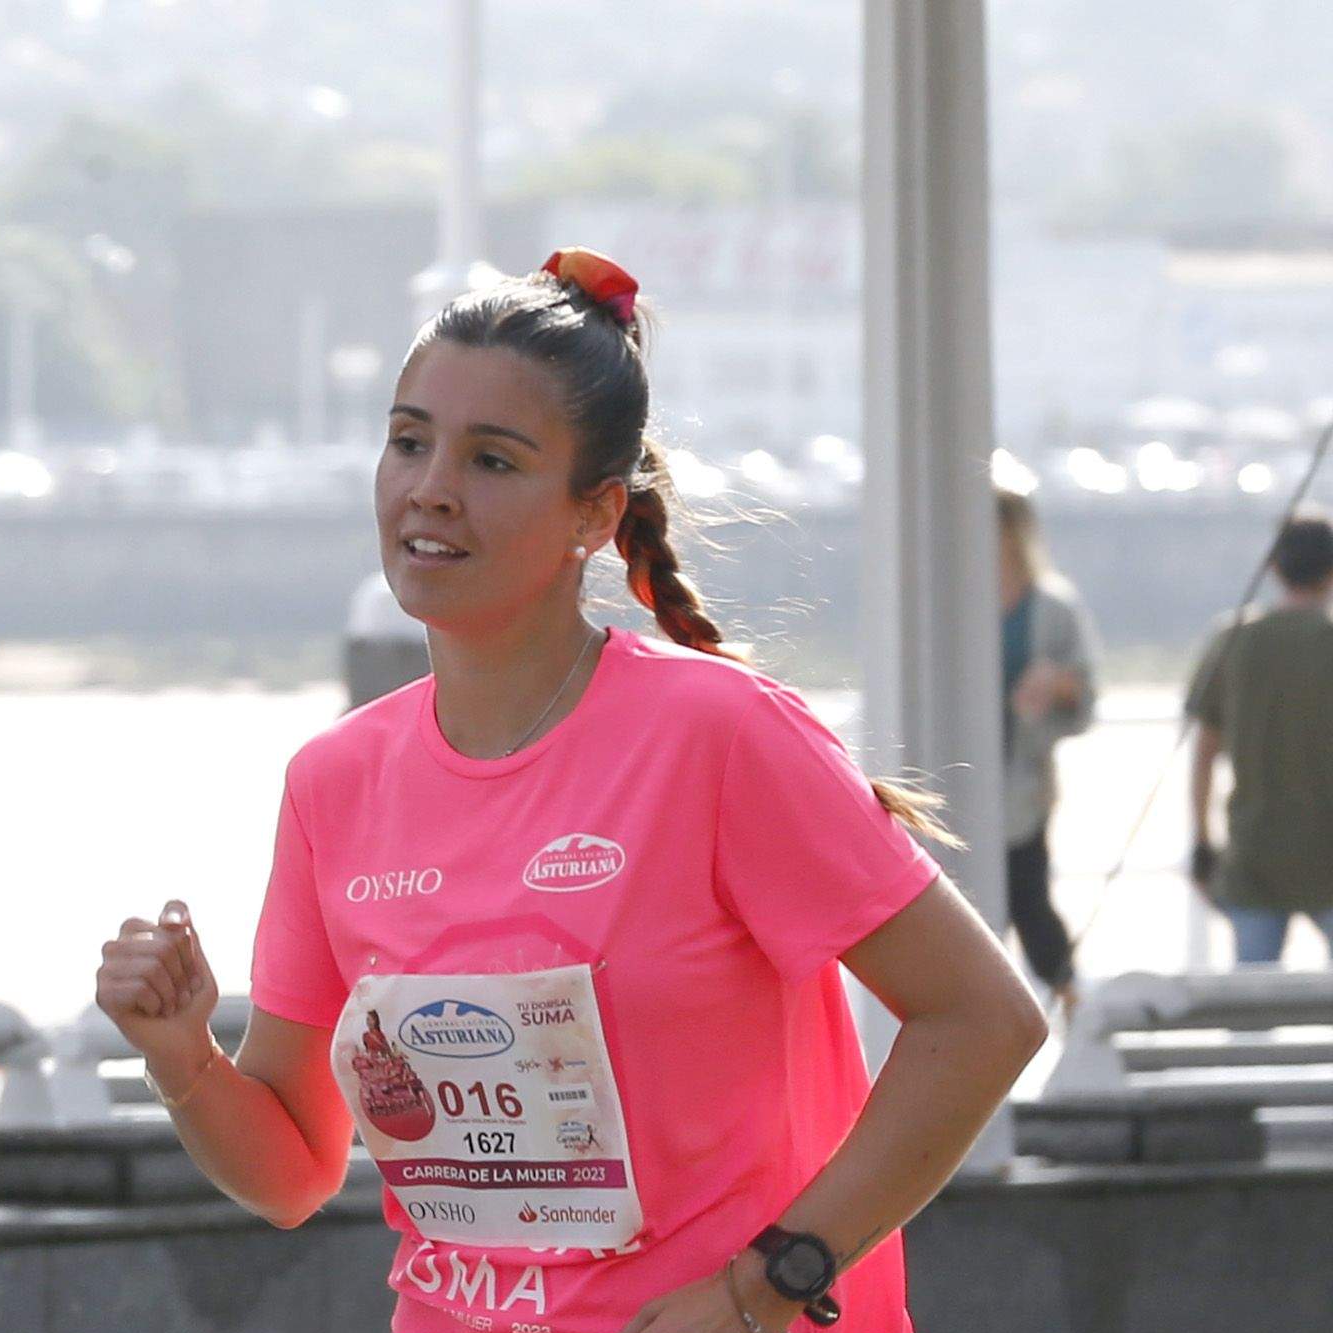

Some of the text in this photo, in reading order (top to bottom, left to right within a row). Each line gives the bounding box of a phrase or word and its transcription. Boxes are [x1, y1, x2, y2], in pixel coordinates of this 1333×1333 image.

[529, 857, 617, 881] ASTURIANA
[346, 868, 443, 902] OYSHO
[532, 999, 573, 1010] DORSAL
[521, 1008, 575, 1026] SUMA
[410, 1025, 507, 1045] ASTURIANA
[437, 1080, 523, 1118] 016
[463, 1132, 515, 1154] 1627
[403, 1165, 605, 1182] CARRERA DE LA MUJER 2023
[408, 1201, 616, 1225] OYSHO Santander
